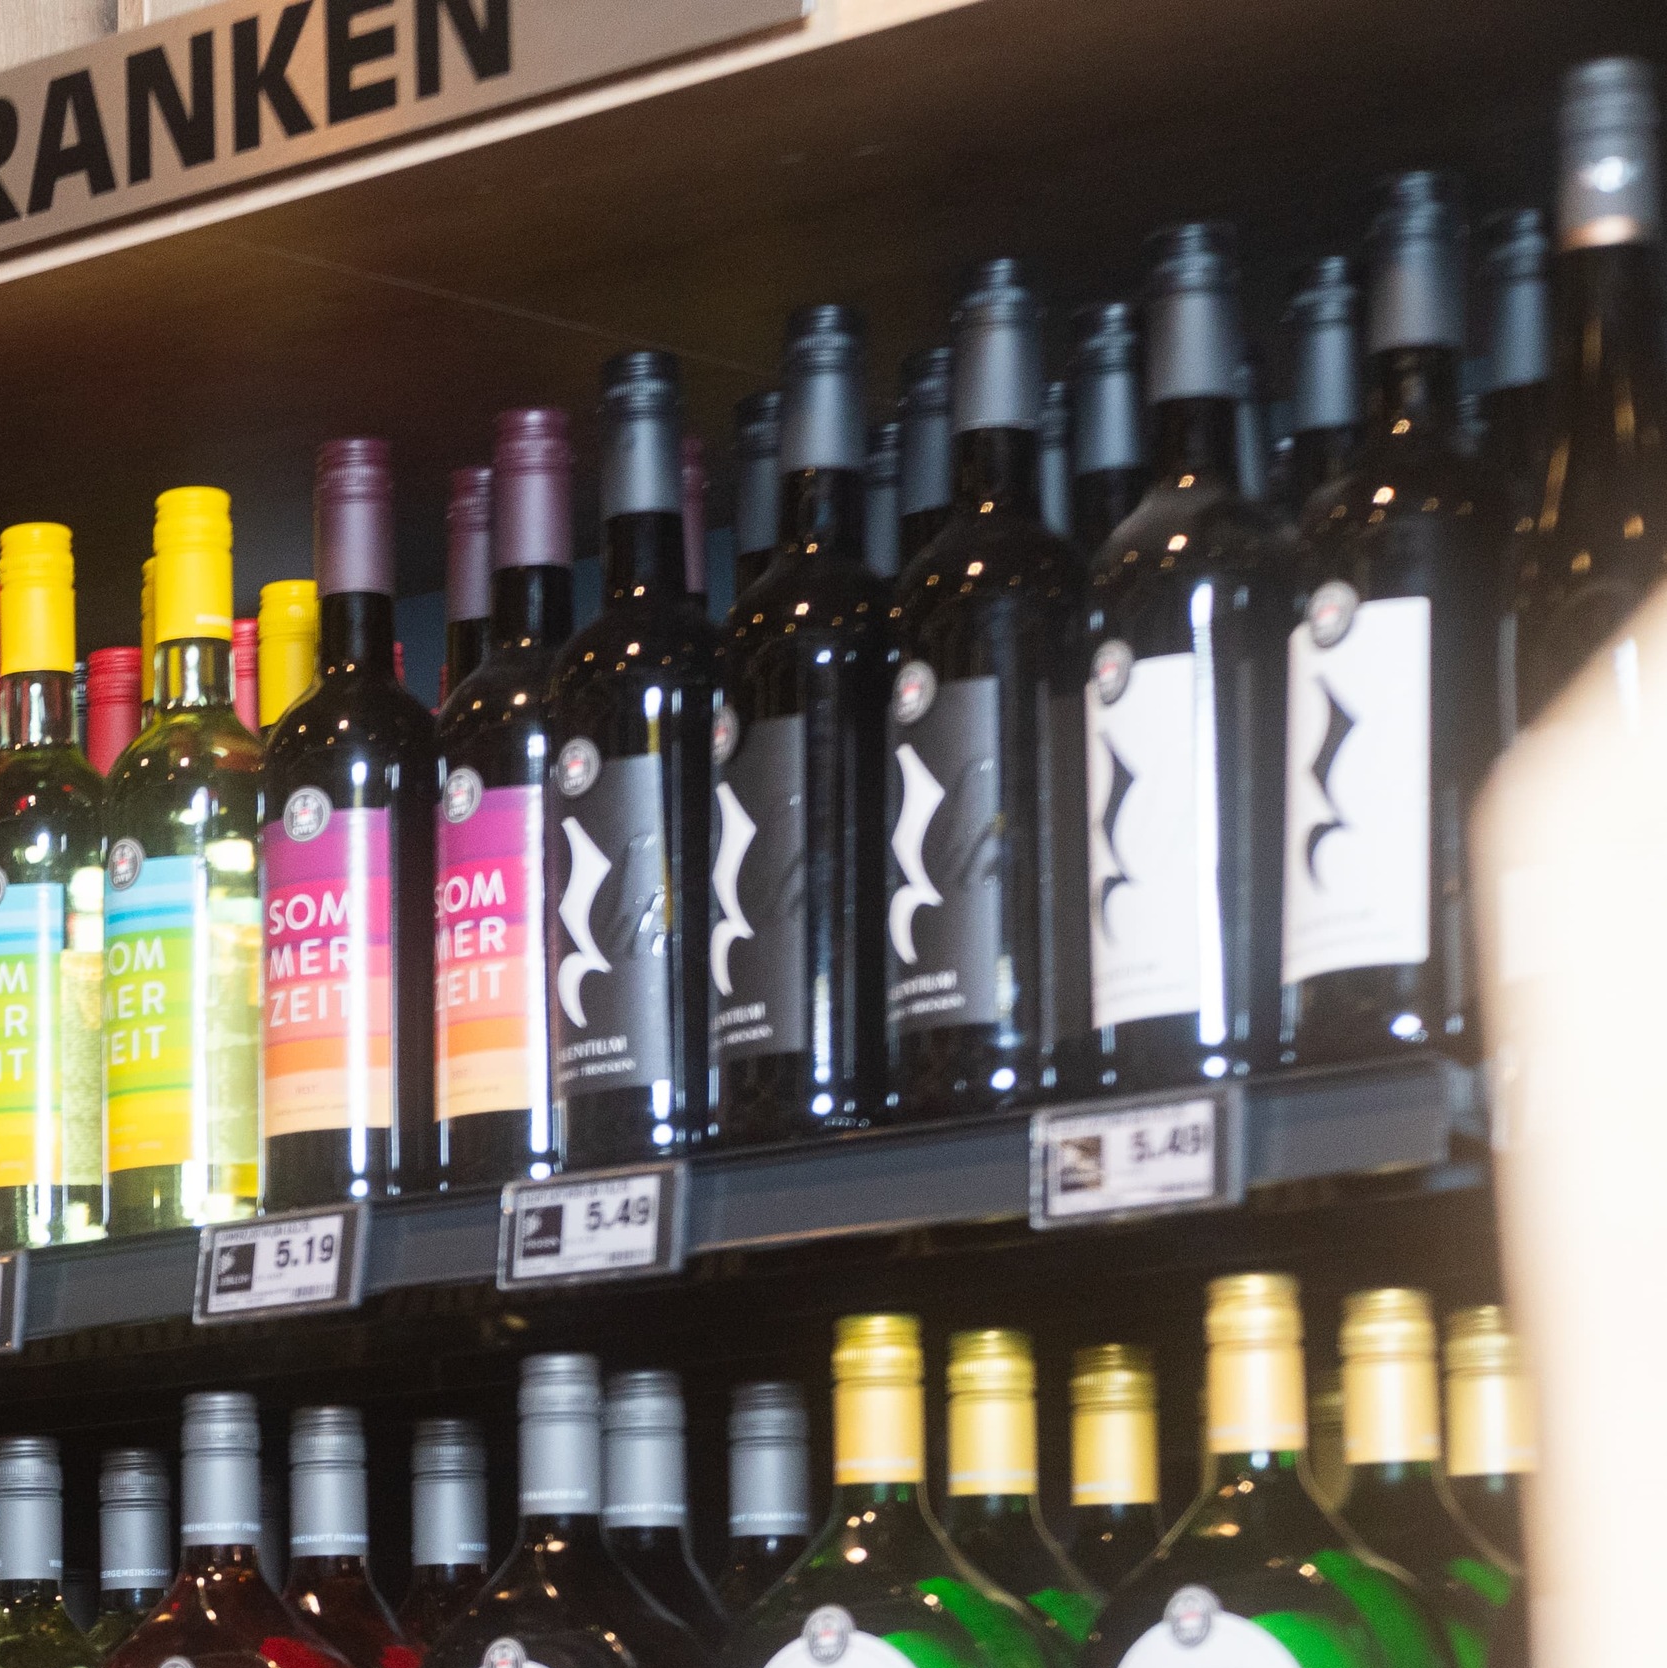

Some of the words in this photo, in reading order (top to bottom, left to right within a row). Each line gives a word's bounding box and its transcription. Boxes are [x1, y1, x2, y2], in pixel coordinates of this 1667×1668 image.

[268, 893, 352, 936] SOM
[268, 935, 352, 982] MER
[269, 983, 352, 1029] ZEIT
[583, 1195, 650, 1235] 5.49
[275, 1233, 335, 1270] 5.19
